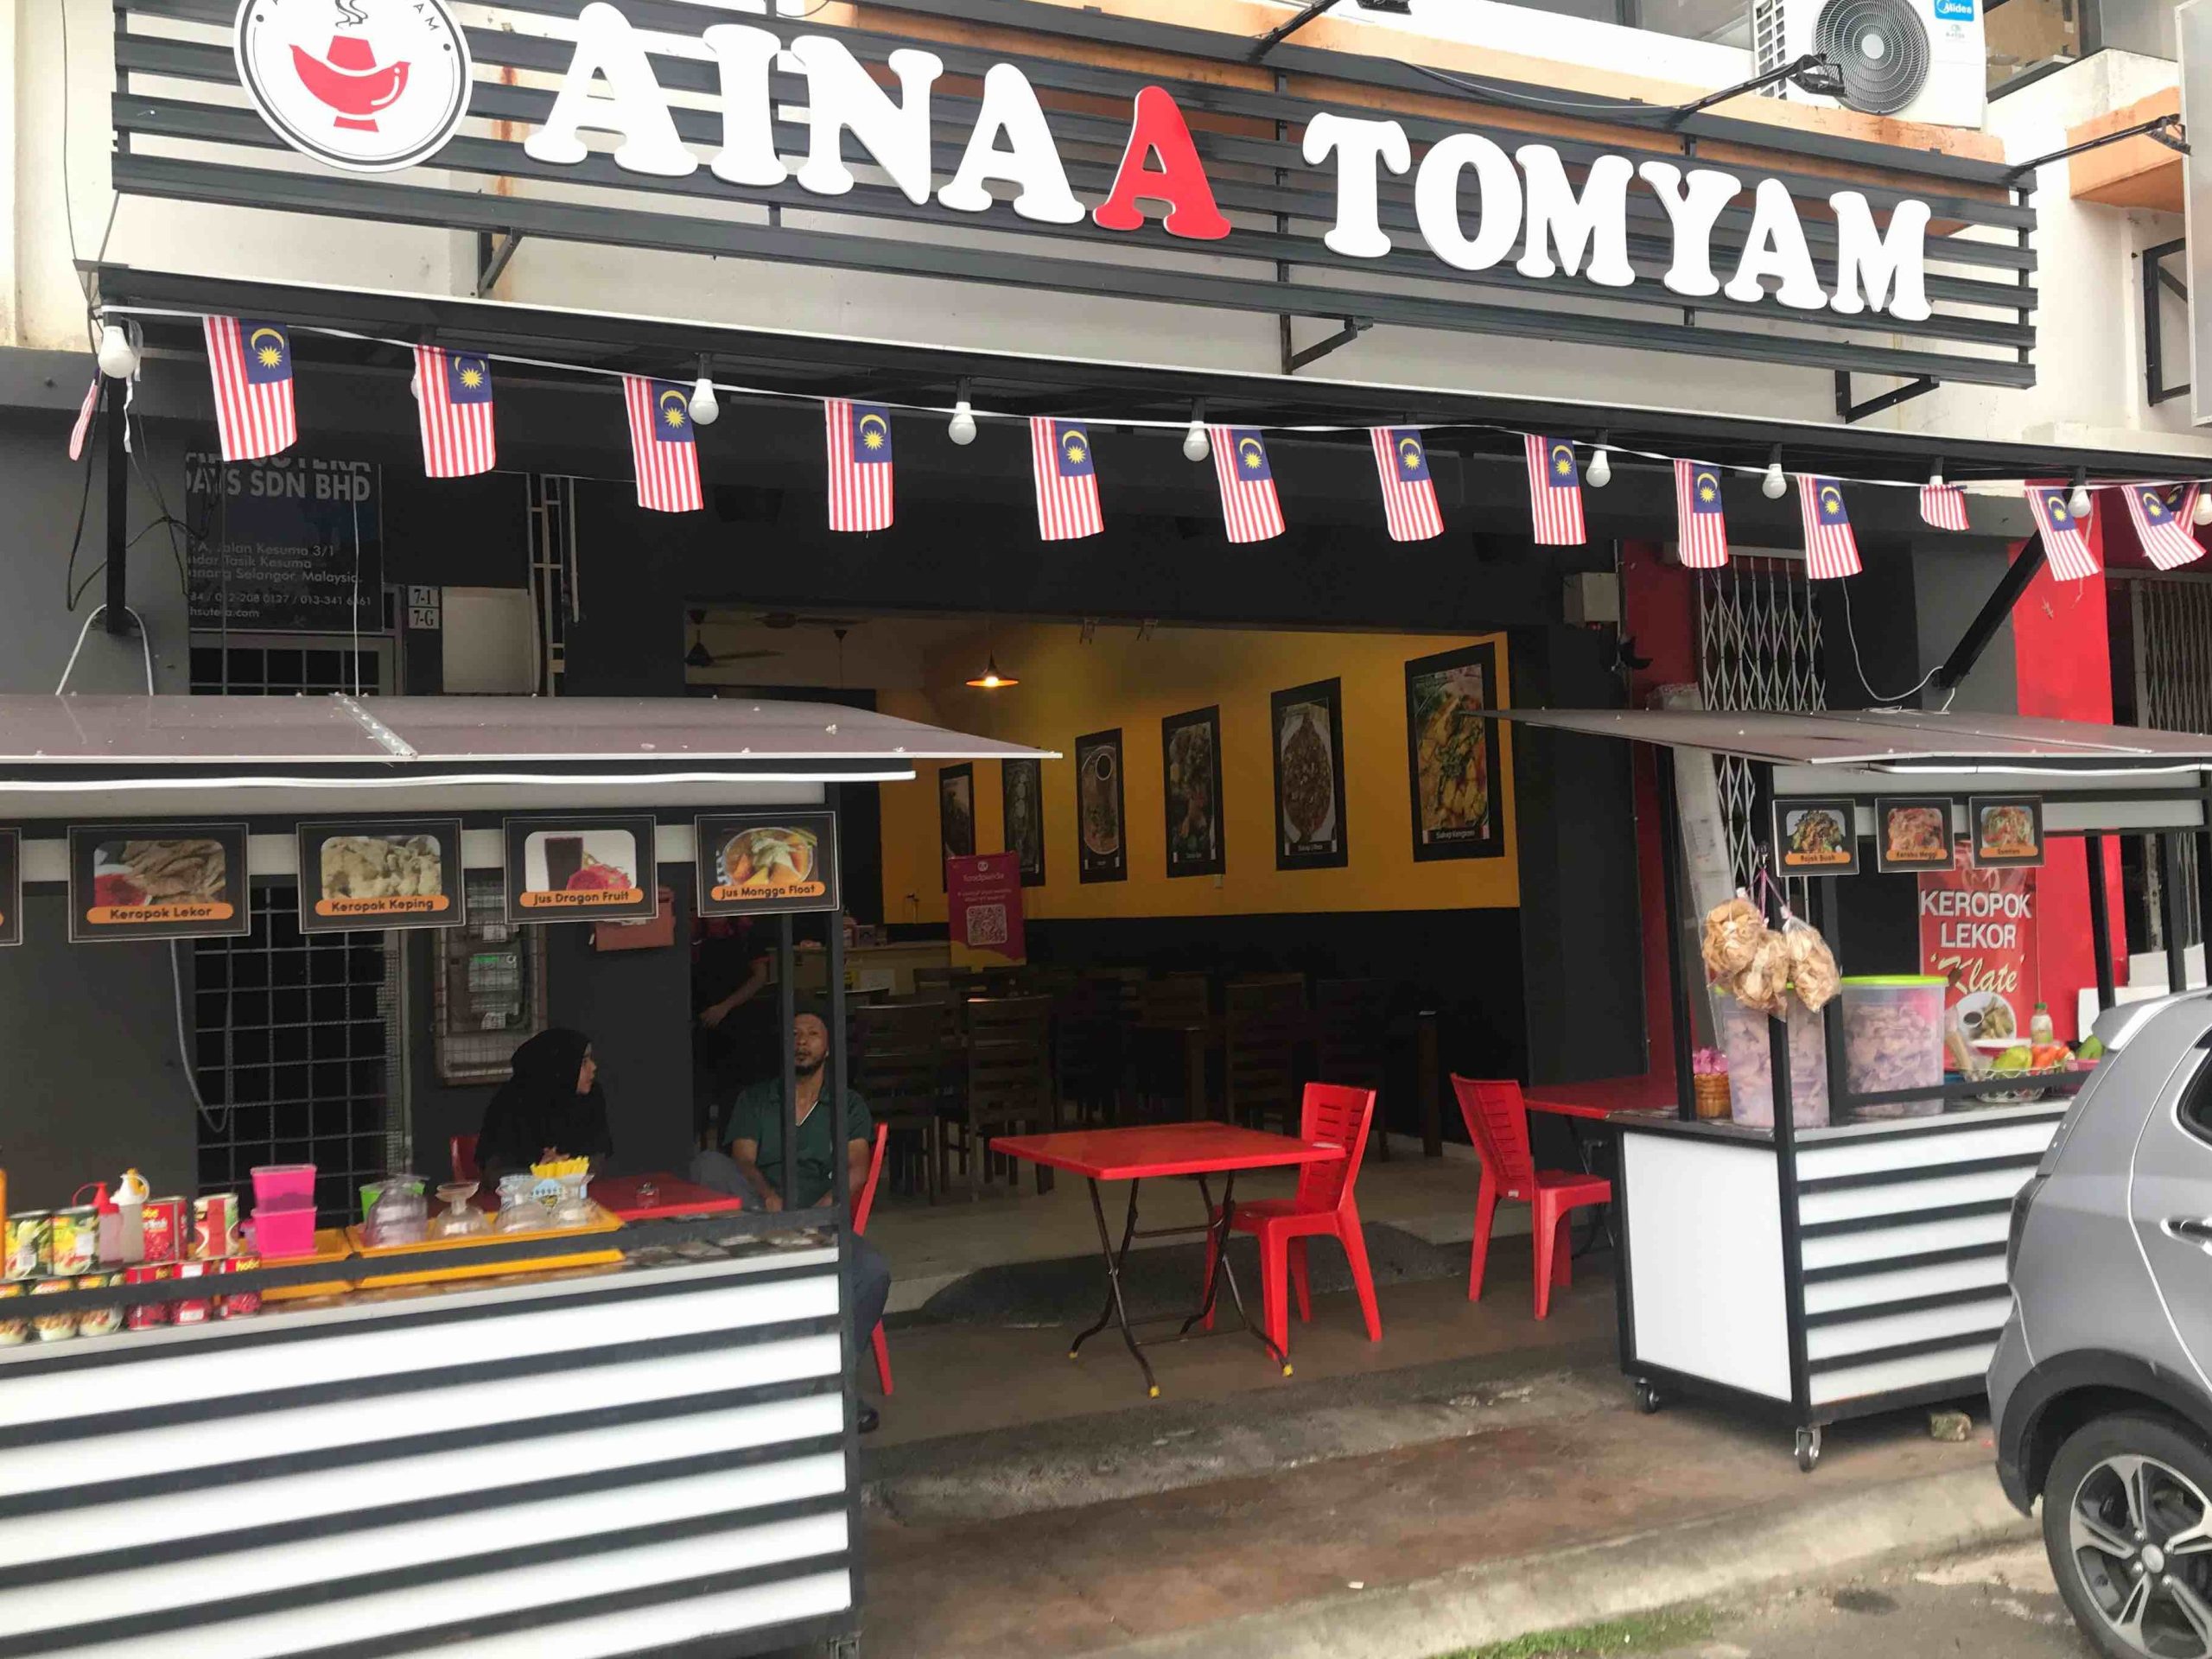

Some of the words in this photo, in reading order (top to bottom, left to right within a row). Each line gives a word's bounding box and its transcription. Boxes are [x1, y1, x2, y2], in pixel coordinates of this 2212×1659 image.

[1302, 111, 1932, 321] TOMYAM
[250, 470, 307, 499] SDN
[316, 474, 371, 502] BHD
[414, 609, 434, 627] 7-G
[533, 892, 552, 906] Jus
[555, 892, 598, 906] Dragon
[601, 890, 629, 903] Fruit
[721, 887, 739, 899] Jus
[741, 885, 785, 899] Mangga
[788, 883, 815, 896] Float
[331, 900, 385, 913] Keropok
[389, 897, 434, 912] Keping
[1920, 889, 2031, 918] KEROPOK
[110, 907, 169, 921] Keropok
[173, 906, 212, 918] Lekor
[1941, 922, 2017, 950] LEKOR
